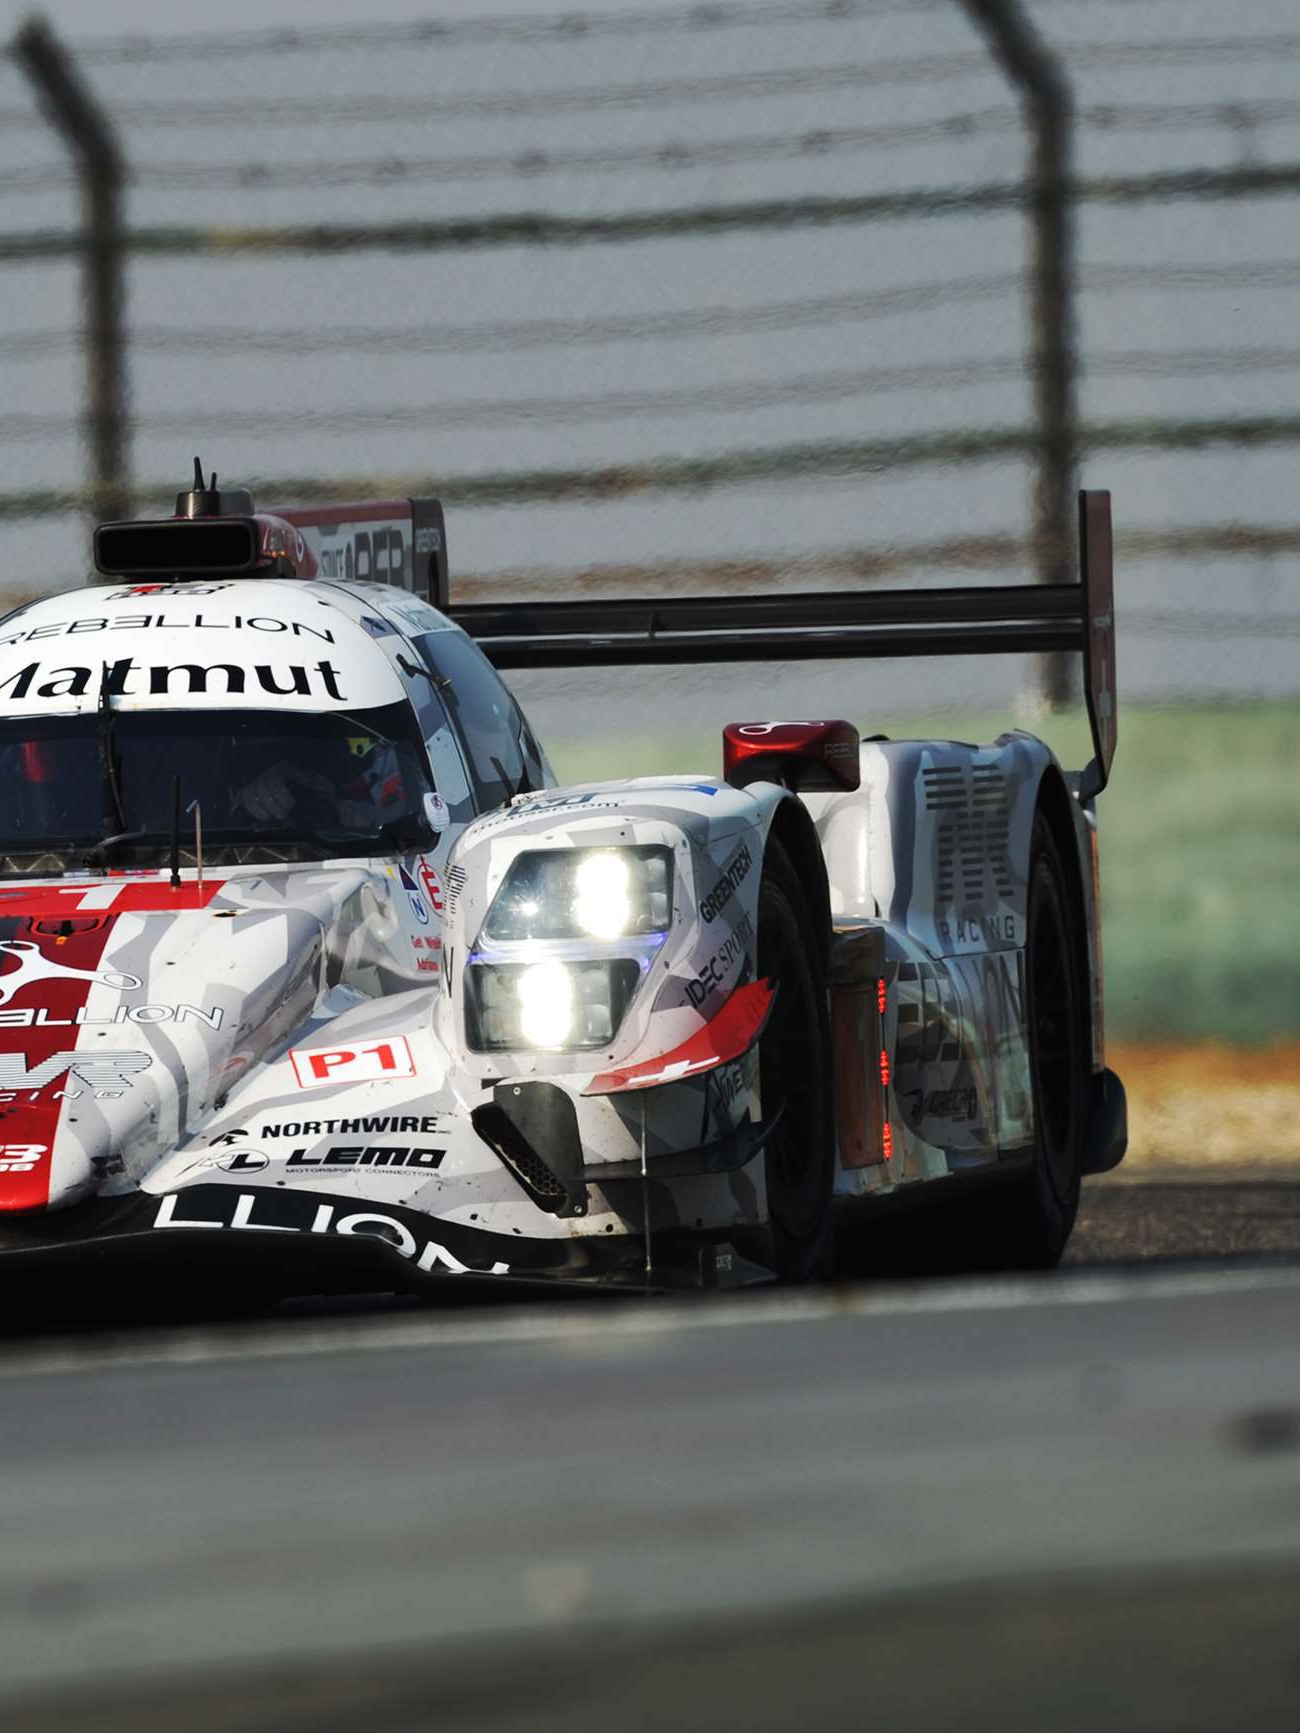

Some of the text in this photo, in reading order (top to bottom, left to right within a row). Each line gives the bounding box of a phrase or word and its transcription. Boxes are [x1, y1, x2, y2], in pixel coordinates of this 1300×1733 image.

[700, 846, 753, 924] GREENTECH
[718, 911, 755, 971] SPORT
[939, 915, 1016, 944] RACING
[308, 1044, 397, 1079] P1
[261, 1116, 438, 1139] NORTHWIRE
[285, 1147, 447, 1169] LEMO
[364, 1168, 441, 1178] CONNECTORS
